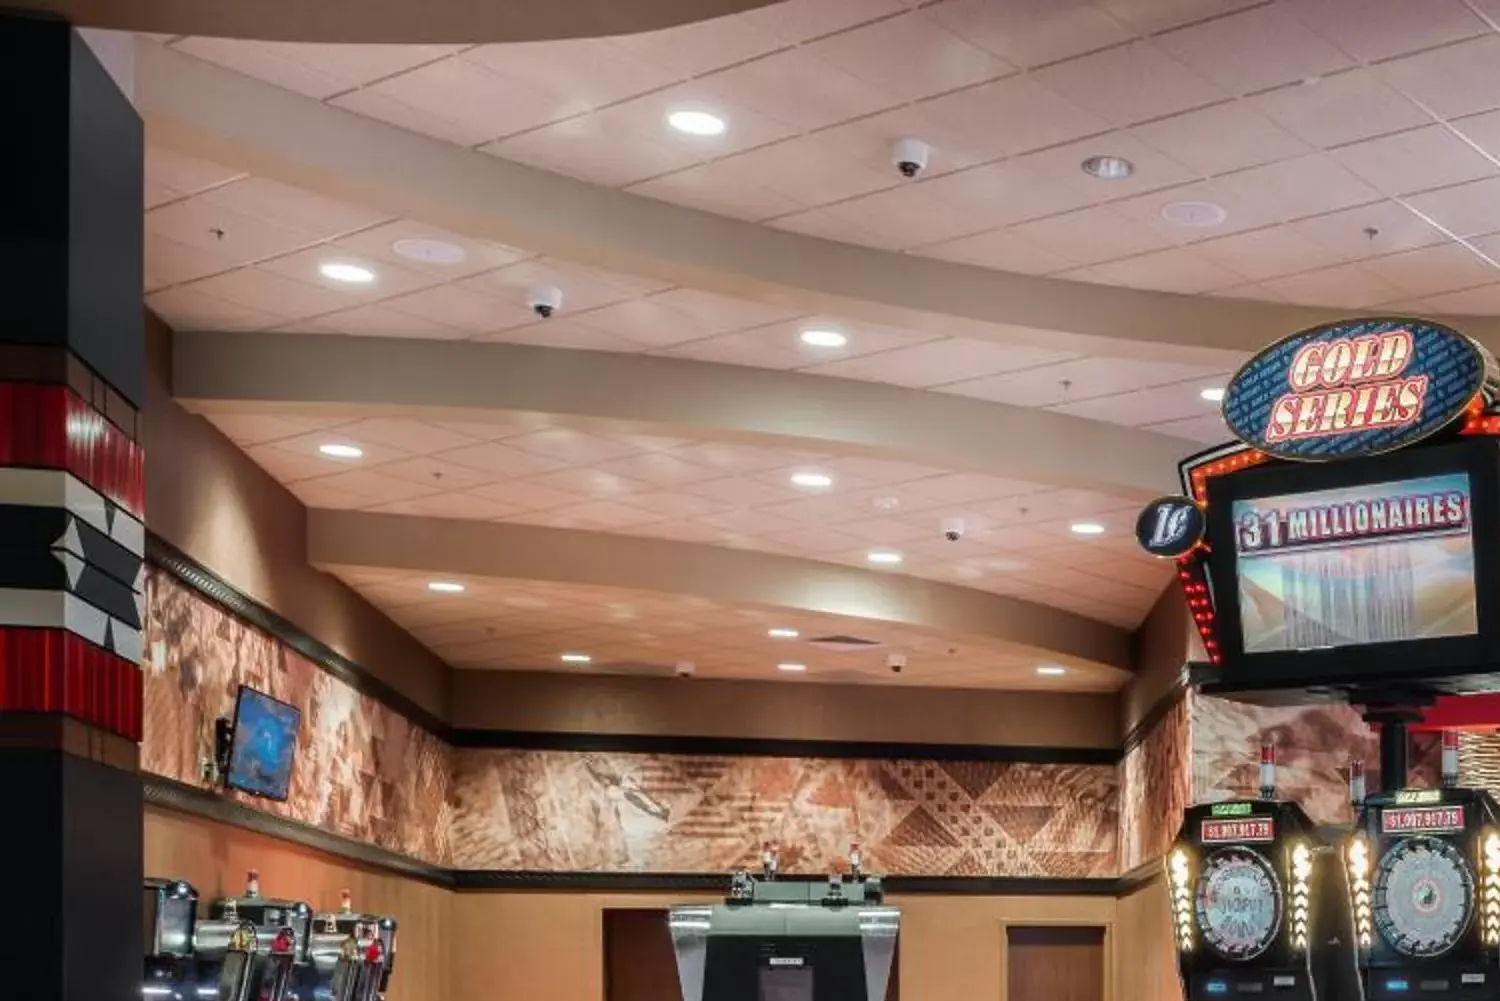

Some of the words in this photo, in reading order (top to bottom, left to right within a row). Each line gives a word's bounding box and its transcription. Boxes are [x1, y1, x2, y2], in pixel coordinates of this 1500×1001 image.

[1290, 331, 1413, 391] GOLD
[1266, 376, 1428, 442] SERIES
[1241, 511, 1282, 546] 31
[1287, 494, 1463, 540] MILLIONAIRES
